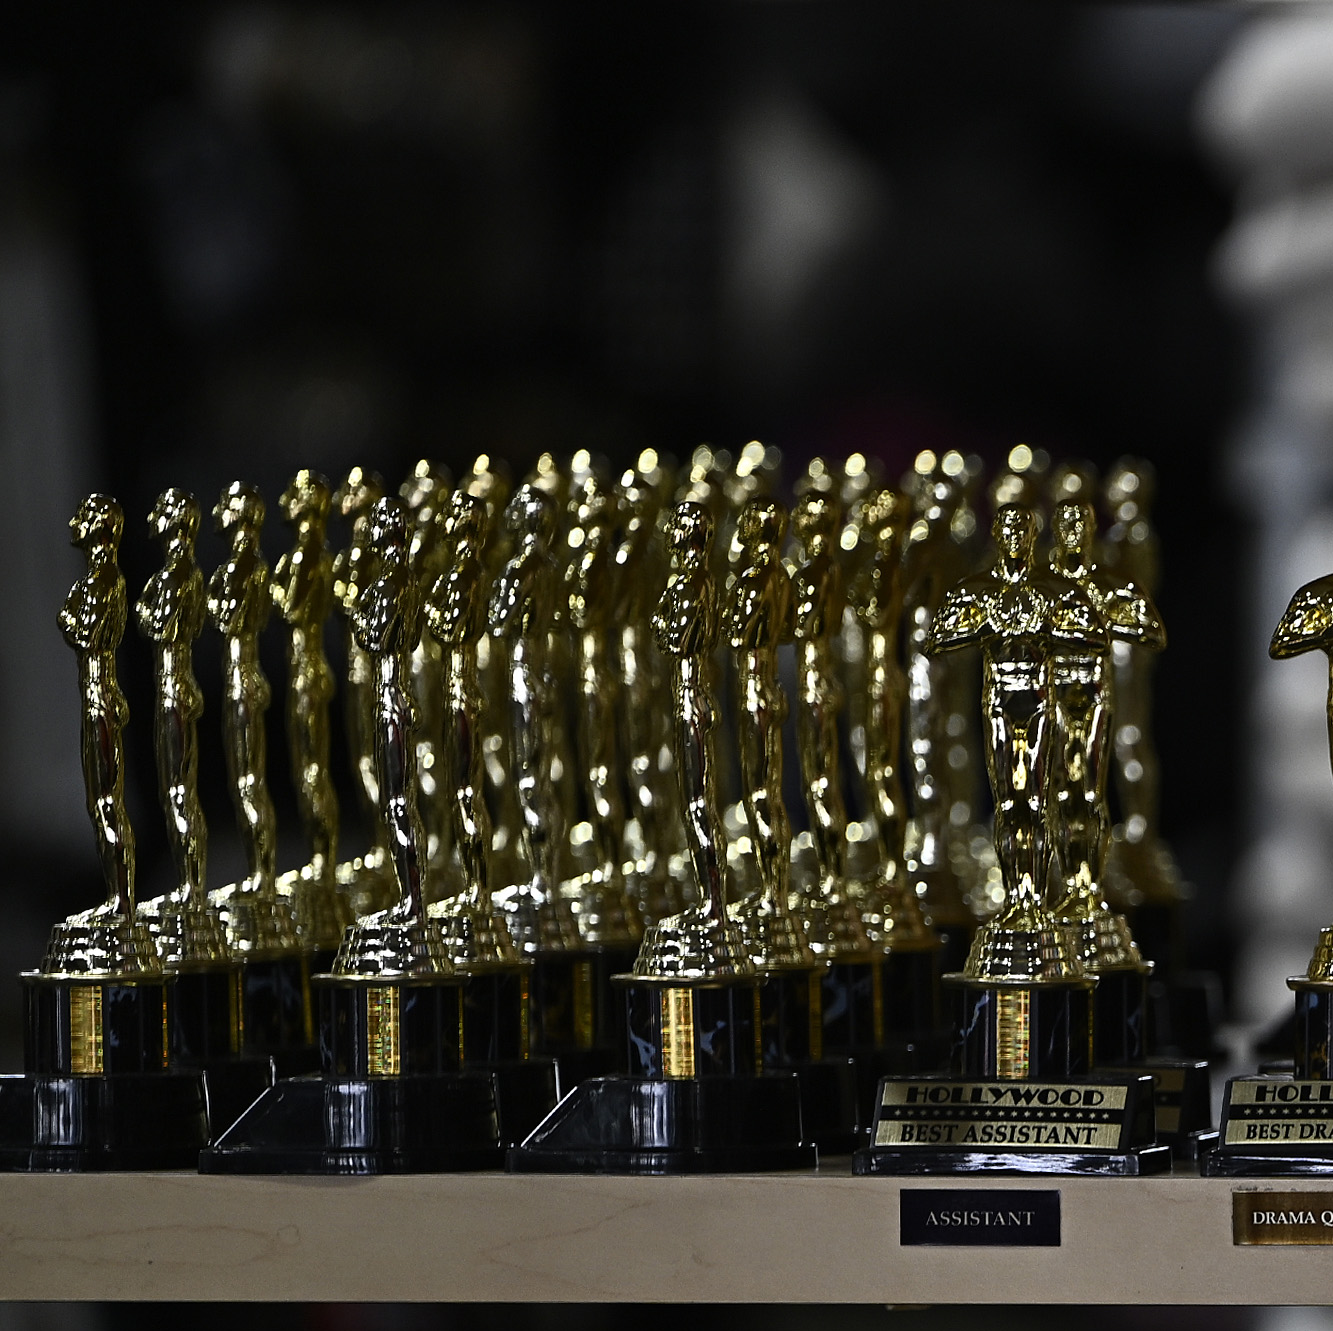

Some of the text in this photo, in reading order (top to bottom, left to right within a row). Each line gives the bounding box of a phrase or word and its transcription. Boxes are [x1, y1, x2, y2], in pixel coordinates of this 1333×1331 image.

[906, 1086, 1105, 1106] HOLLYWOOD
[900, 1124, 1098, 1145] BEST ASSISTANT
[1245, 1123, 1296, 1140] BEST
[926, 1211, 1036, 1227] ASSISTANT
[1253, 1210, 1316, 1225] DRAMA
